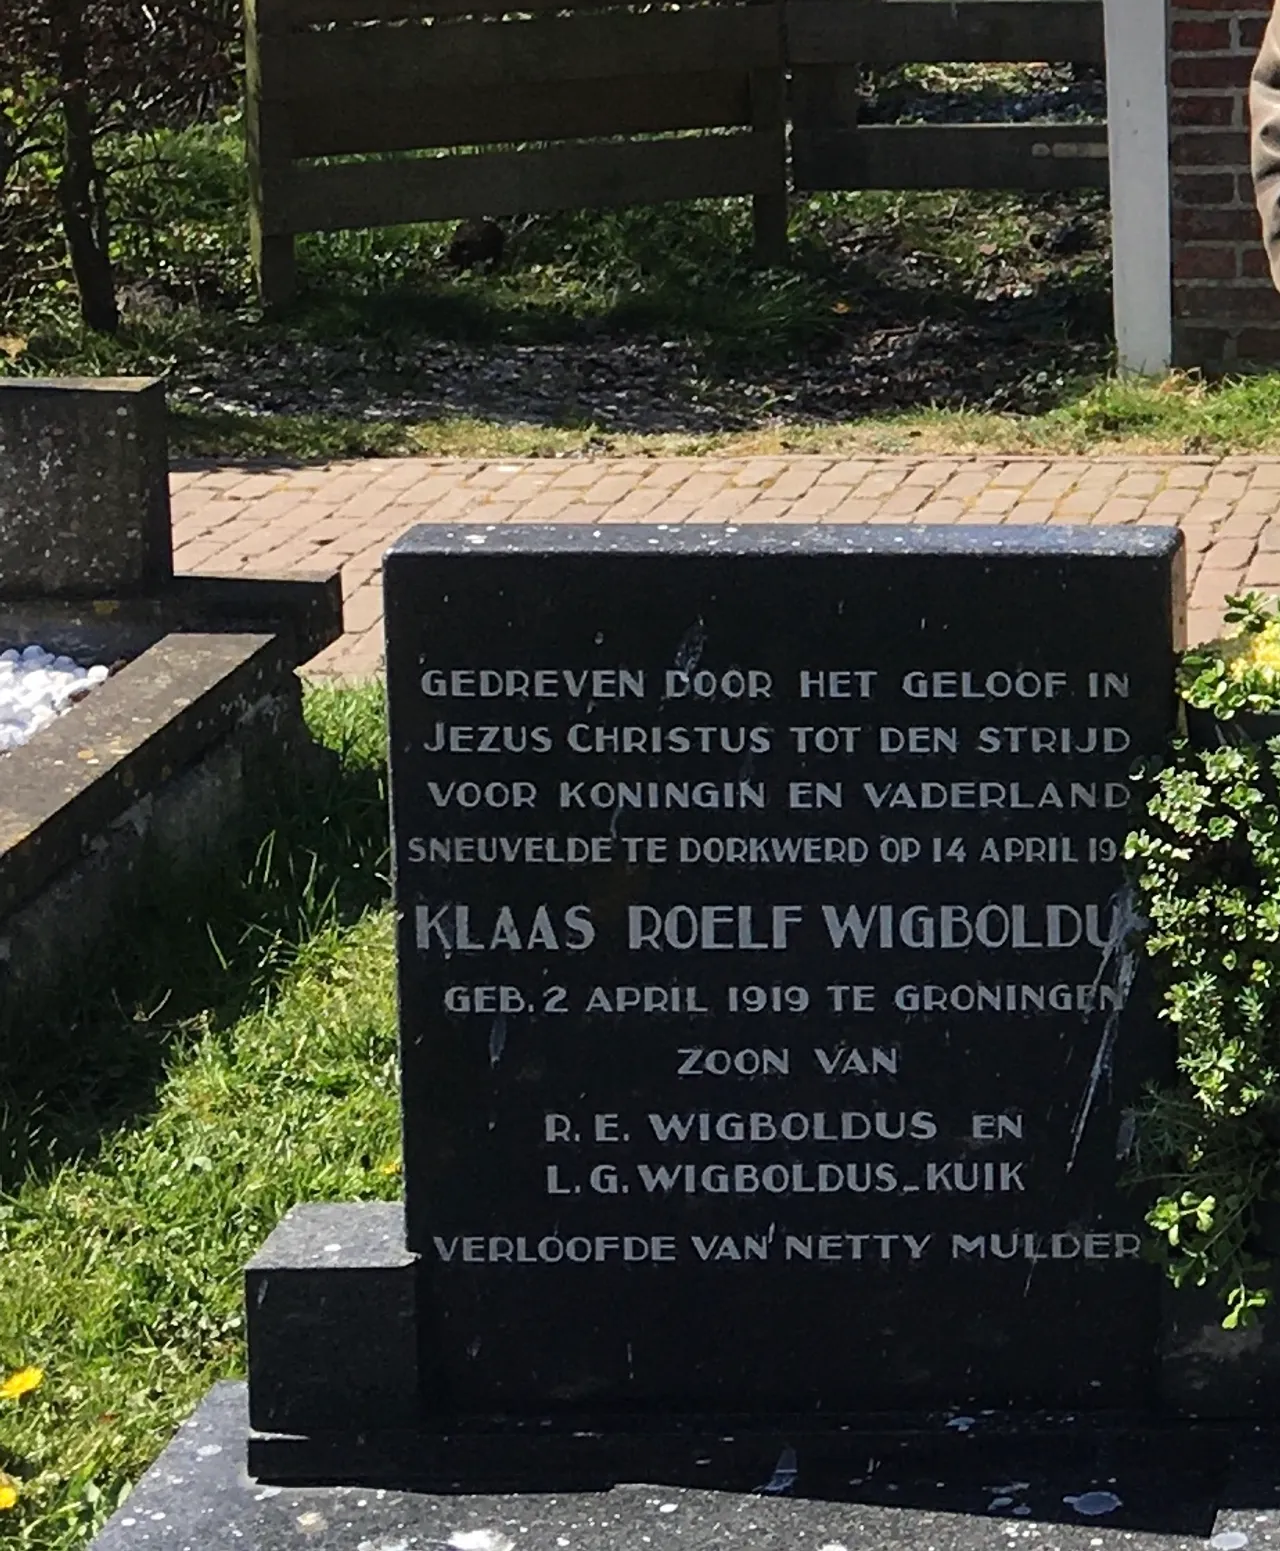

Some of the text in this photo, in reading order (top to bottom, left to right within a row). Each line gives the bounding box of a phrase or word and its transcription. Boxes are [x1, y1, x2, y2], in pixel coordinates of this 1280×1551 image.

[420, 668, 1130, 700] GEDREVEN DOOR HET GELOOF IN
[789, 725, 862, 754] TOT
[879, 726, 958, 754] DEN
[977, 726, 1131, 754] STRIJD
[426, 780, 1132, 810] VOOR KONINGIN EN VADERLAND
[407, 836, 1119, 864] SNEUVELDE TE DORKWERD OP 14 APRIL 19
[415, 903, 1120, 951] KLAAS ROELF WIGBOLDU
[443, 983, 1126, 1014] GEB. 2 APRIL 1919 TE GRONINGEN
[676, 1047, 899, 1076] ZOON VAN
[544, 1110, 1024, 1143] R. E. WIGBOLDUS EN
[546, 1164, 581, 1195] L.
[589, 1163, 629, 1195] G.
[432, 1232, 1142, 1263] VERLOOFDE VAN NETTY MULDER
